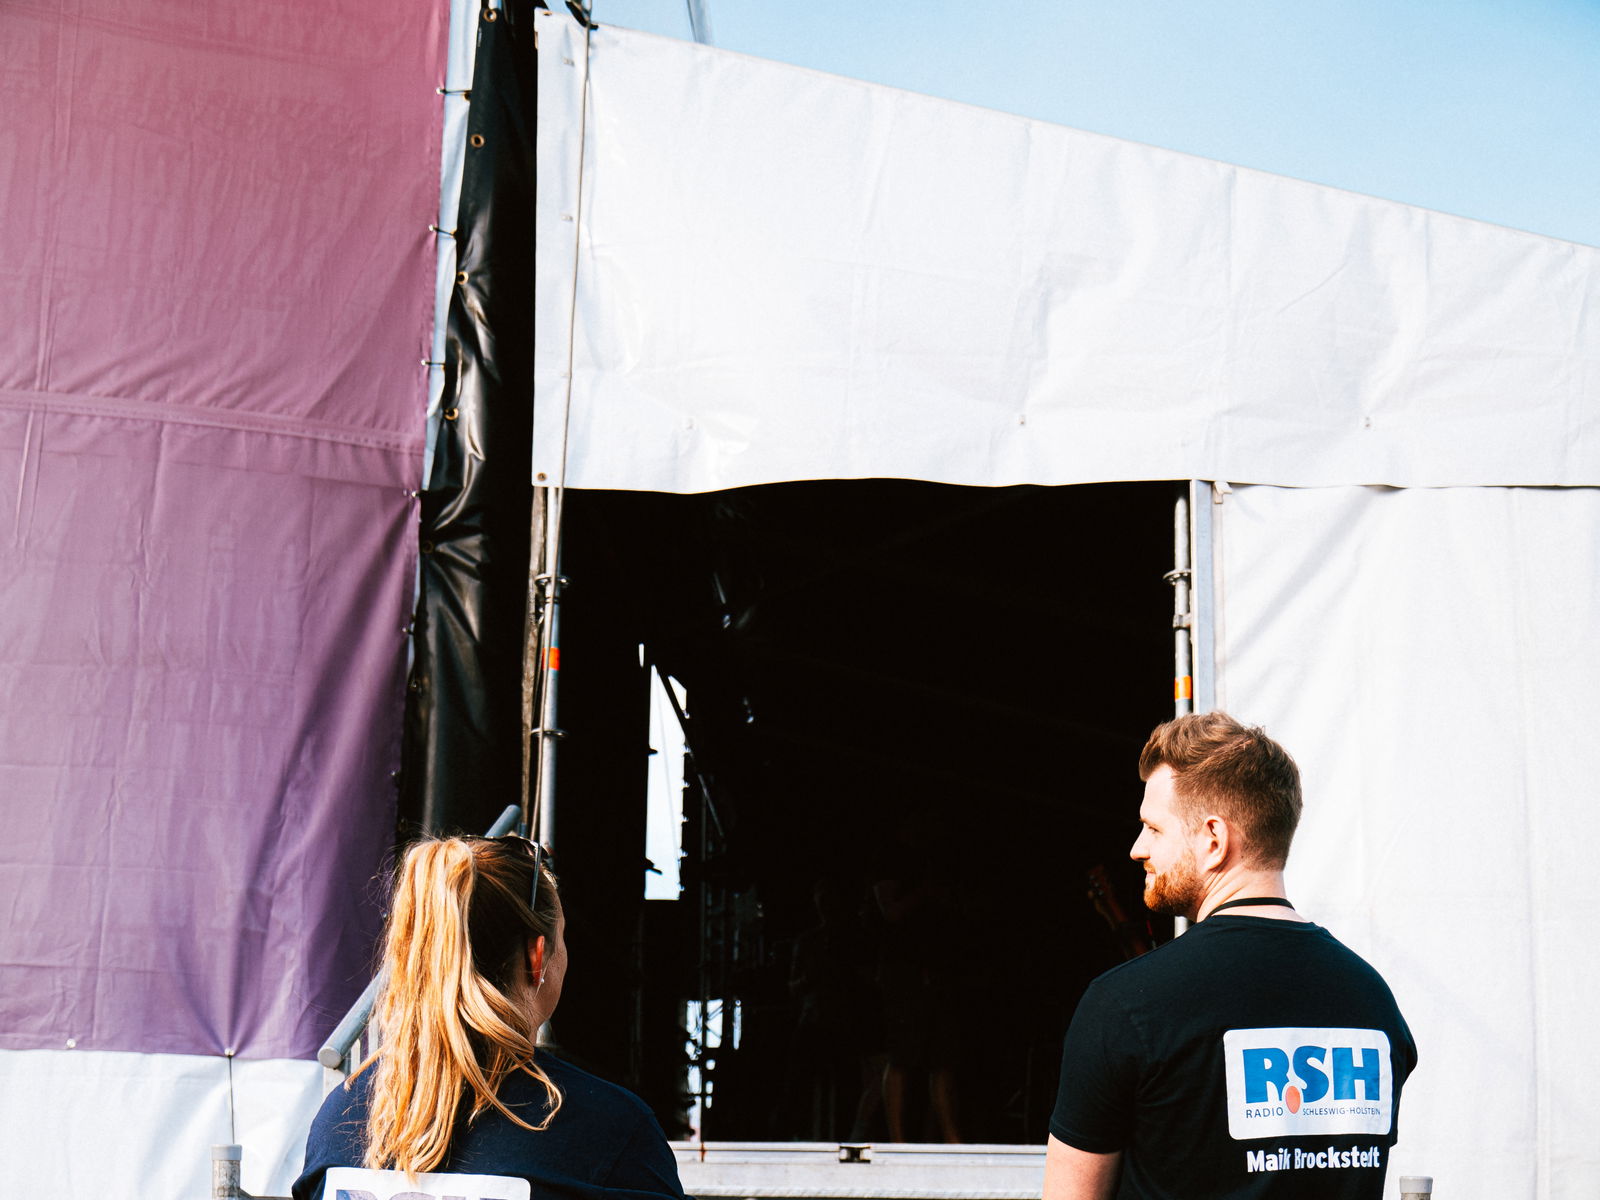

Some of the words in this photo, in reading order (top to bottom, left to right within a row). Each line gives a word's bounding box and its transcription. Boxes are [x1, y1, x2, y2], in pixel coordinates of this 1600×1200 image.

[1242, 1045, 1380, 1104] RSH
[1245, 1106, 1284, 1119] RADIO
[1302, 1106, 1381, 1116] SCHLESWIG-HOLSTEIN
[1246, 1147, 1291, 1173] Maik
